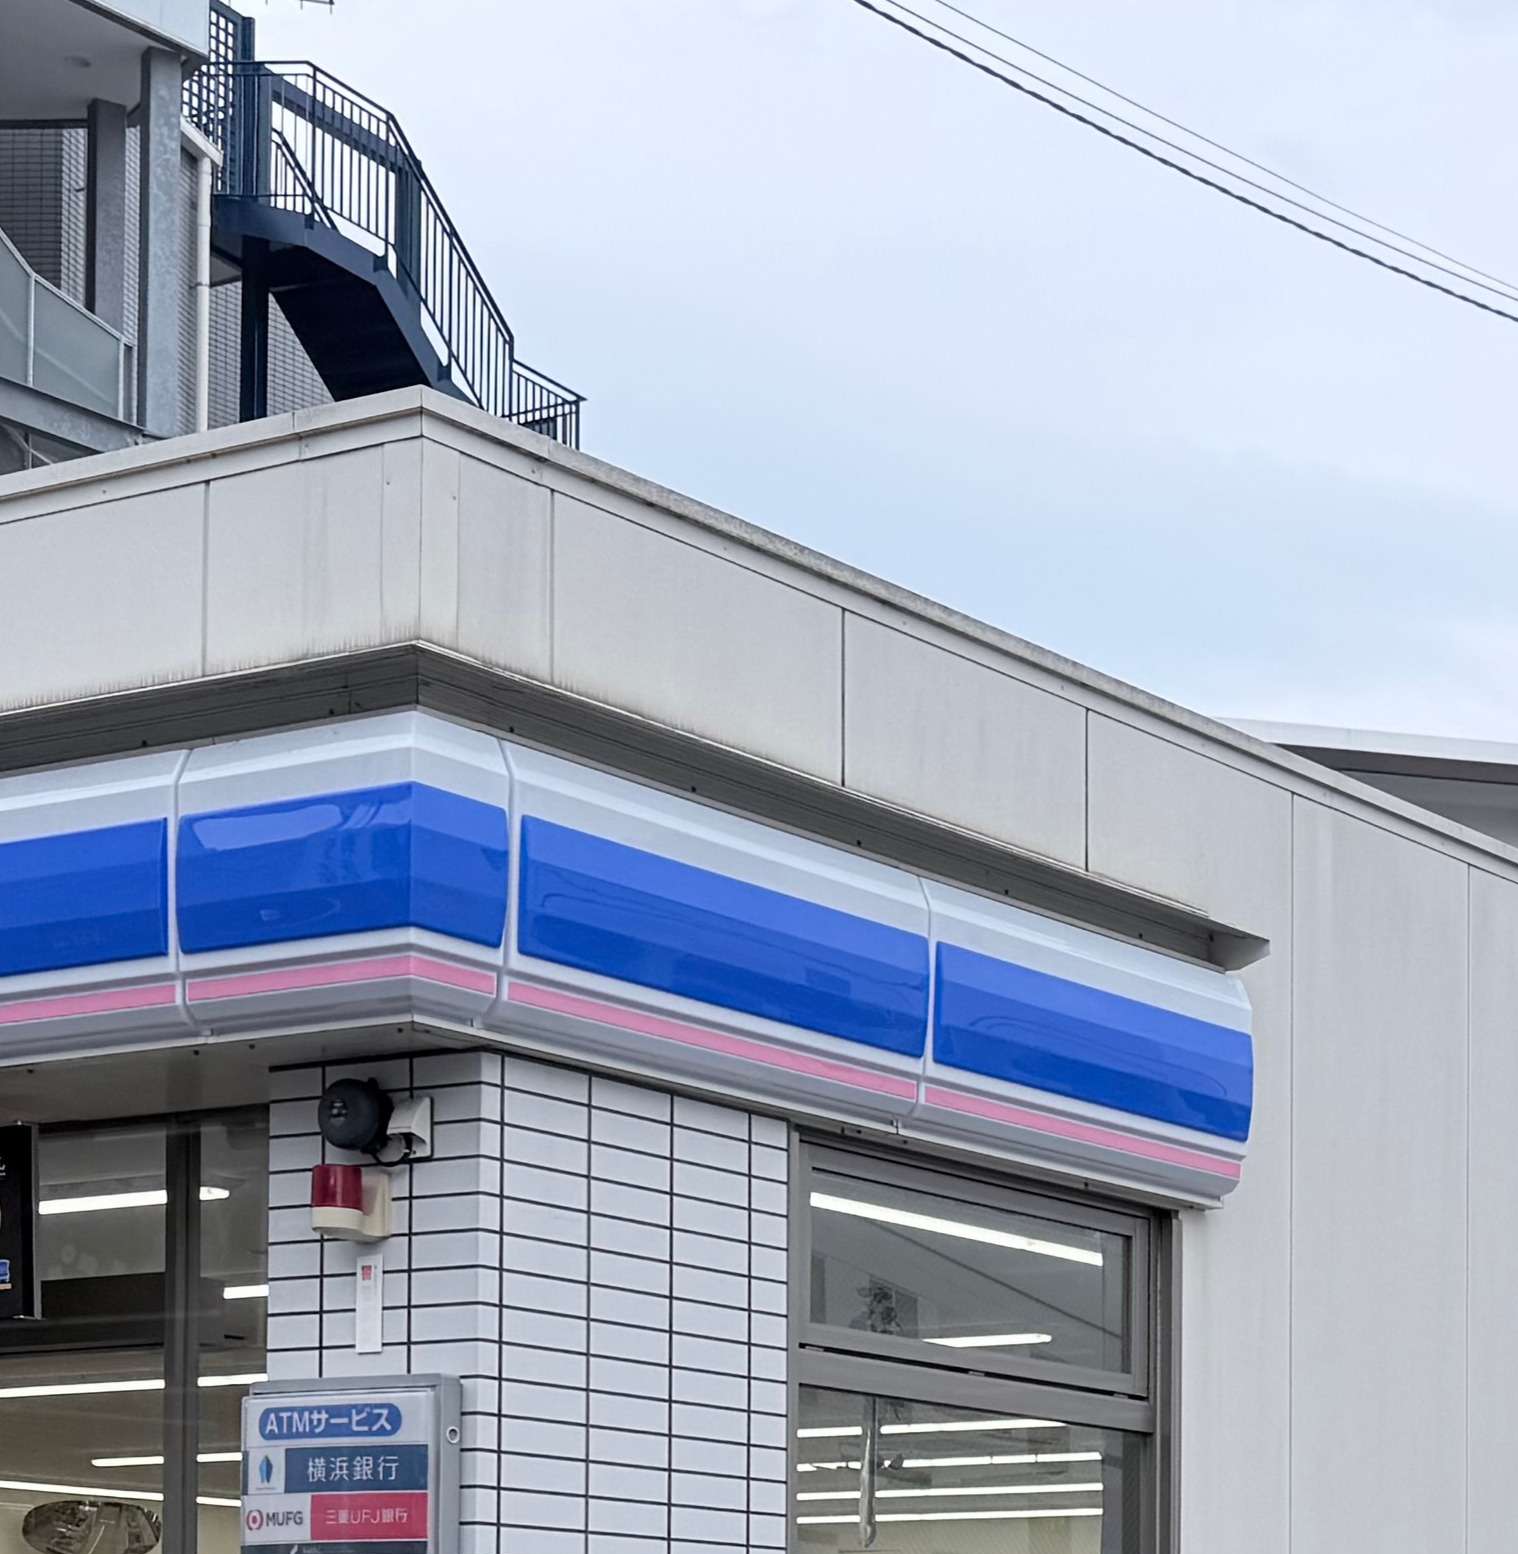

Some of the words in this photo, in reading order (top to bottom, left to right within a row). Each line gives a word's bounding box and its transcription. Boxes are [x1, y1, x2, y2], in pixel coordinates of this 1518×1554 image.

[265, 1408, 392, 1434] ATMサービス
[308, 1456, 399, 1482] 横浜銀行
[266, 1511, 304, 1526] MUFG
[325, 1508, 409, 1525] 三菱UFJ銀行
